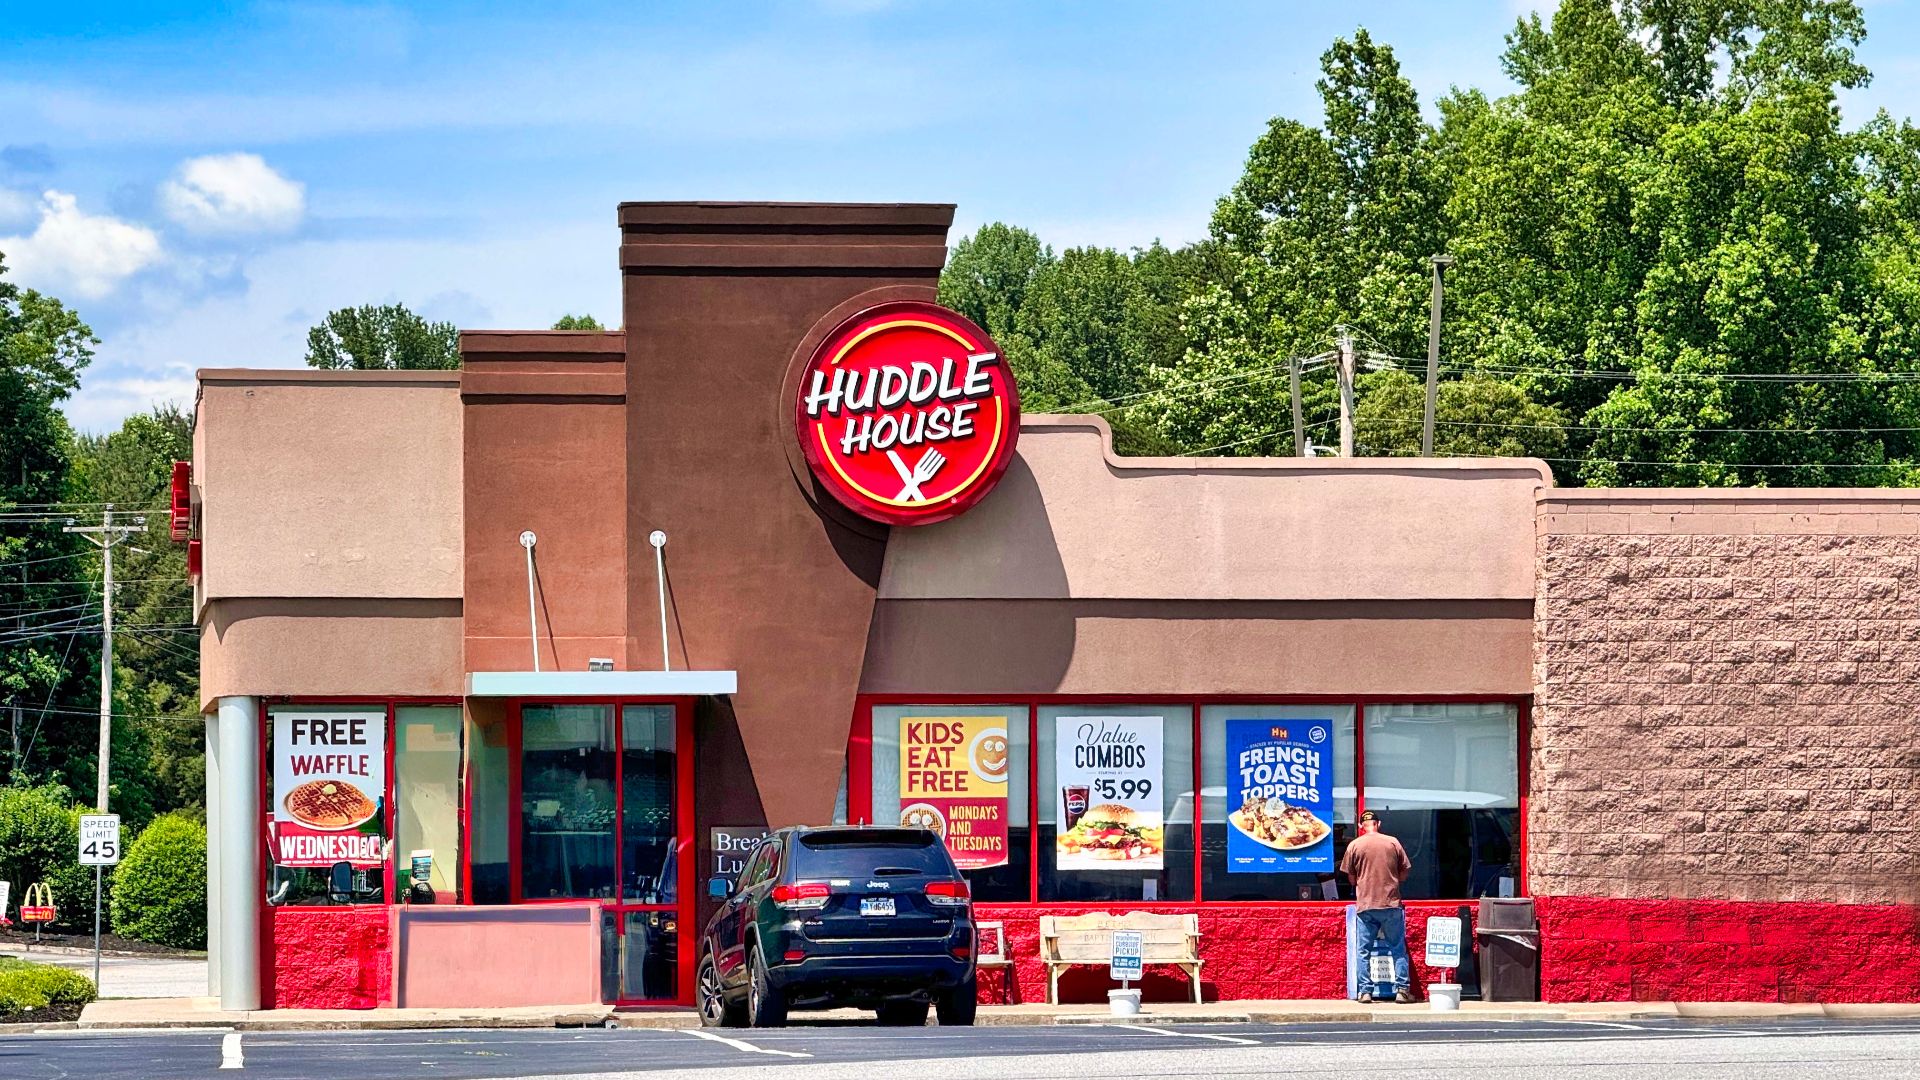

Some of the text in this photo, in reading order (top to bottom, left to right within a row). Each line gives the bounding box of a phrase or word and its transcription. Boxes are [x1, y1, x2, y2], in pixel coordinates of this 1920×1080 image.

[804, 352, 998, 416] HUDDLE
[840, 403, 978, 455] HOUSE
[291, 719, 367, 745] FREE
[907, 722, 965, 745] KIDS
[1077, 720, 1137, 745] Value
[290, 754, 370, 777] WAFFLE
[907, 747, 956, 768] EAT
[1075, 744, 1146, 768] COMBOS
[1240, 746, 1320, 768] FRENCH
[907, 771, 969, 792] FREE
[1240, 763, 1320, 788] TOAST
[1094, 778, 1152, 801] $5.99
[1240, 784, 1320, 805] TOPPERS
[949, 805, 998, 820] MONDAYS
[83, 820, 116, 828] SPEED
[949, 821, 971, 835] AND
[83, 841, 116, 858] 45
[949, 836, 1002, 851] TUESDAYS
[716, 855, 745, 874] Lu
[866, 880, 890, 890] Jeep
[1432, 934, 1457, 942] PICKUP
[1115, 947, 1139, 955] PICKUP
